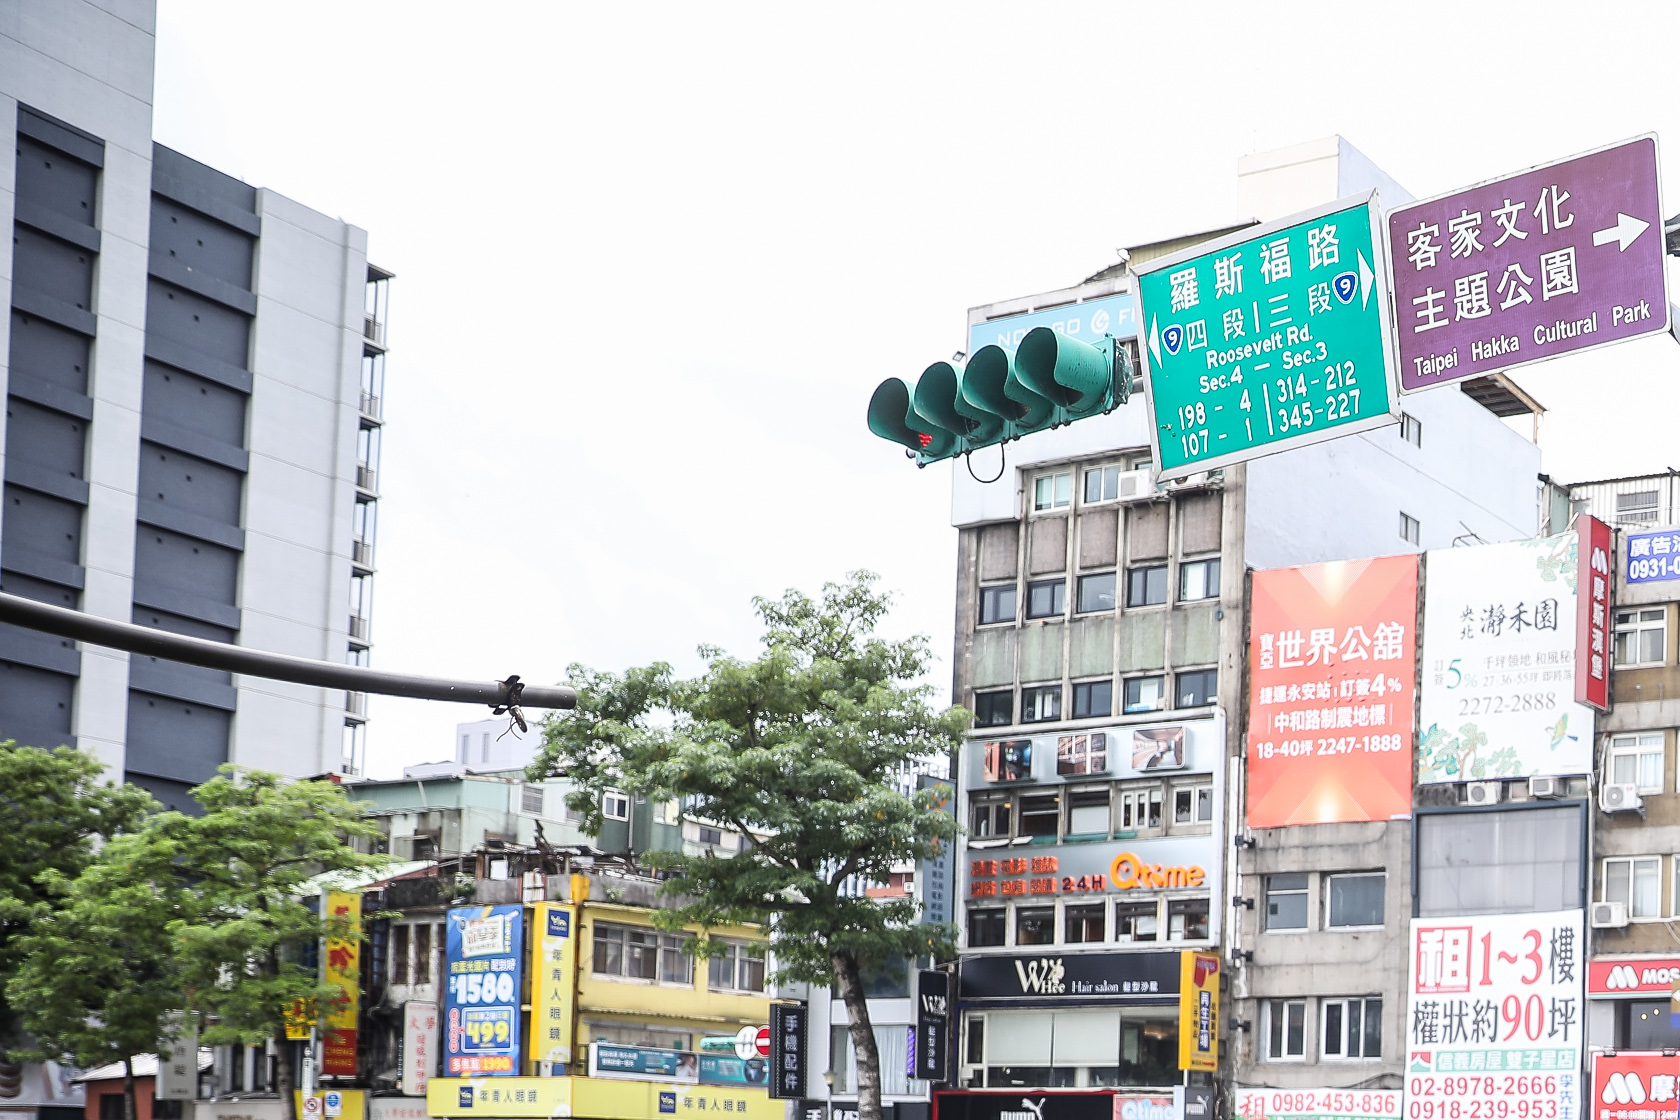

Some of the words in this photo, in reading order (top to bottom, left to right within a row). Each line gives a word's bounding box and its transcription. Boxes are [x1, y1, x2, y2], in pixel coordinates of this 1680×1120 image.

[1406, 184, 1576, 272] 客家文化
[1169, 223, 1342, 315] 羅斯福路
[1338, 276, 1352, 299] 9
[1412, 246, 1580, 335] 主題公園
[1187, 310, 1246, 352] 四段
[1269, 283, 1333, 328] 三段
[1166, 329, 1179, 351] 9
[1205, 336, 1284, 371] Roosevelt
[1287, 328, 1314, 351] Rd.
[1413, 346, 1459, 378] Taipei
[1471, 333, 1520, 363] Hakka
[1533, 312, 1598, 346] Cultural
[1612, 300, 1651, 328] Park
[1199, 363, 1244, 395] Sec.4
[1282, 342, 1329, 371] Sec.3
[1276, 363, 1357, 402] 314-212
[1178, 401, 1207, 428] 198
[1238, 389, 1253, 413] 4
[1278, 390, 1361, 433] 345-227
[1180, 431, 1210, 459] 107
[1460, 604, 1475, 640] 央北
[1259, 632, 1274, 670] 寶亞
[1536, 649, 1576, 666] 和風秘
[1447, 658, 1478, 690] 5%
[1259, 681, 1331, 706] 捷運永安站
[1459, 691, 1556, 717] 2272-2888
[1274, 704, 1386, 733] 中和路制震地標
[1256, 739, 1313, 759] 18-40坪
[1317, 734, 1402, 756] 2247-1888
[1110, 852, 1206, 890] Qtime
[1416, 927, 1472, 990] 租
[456, 972, 514, 1004] 1580
[1072, 980, 1093, 993] Hair
[1095, 980, 1118, 993] salon
[1641, 967, 1680, 985] MOS
[466, 1021, 510, 1044] 499
[1413, 992, 1576, 1046] 權狀約90坪
[784, 1014, 798, 1090] 手機配件
[1437, 1052, 1502, 1071] 信義房屋
[1507, 1049, 1574, 1070] 雙子星店
[1410, 1076, 1557, 1097] 02-8978-2666
[1186, 1104, 1204, 1115] PUMA
[1410, 1100, 1558, 1120] 0918-239-953
